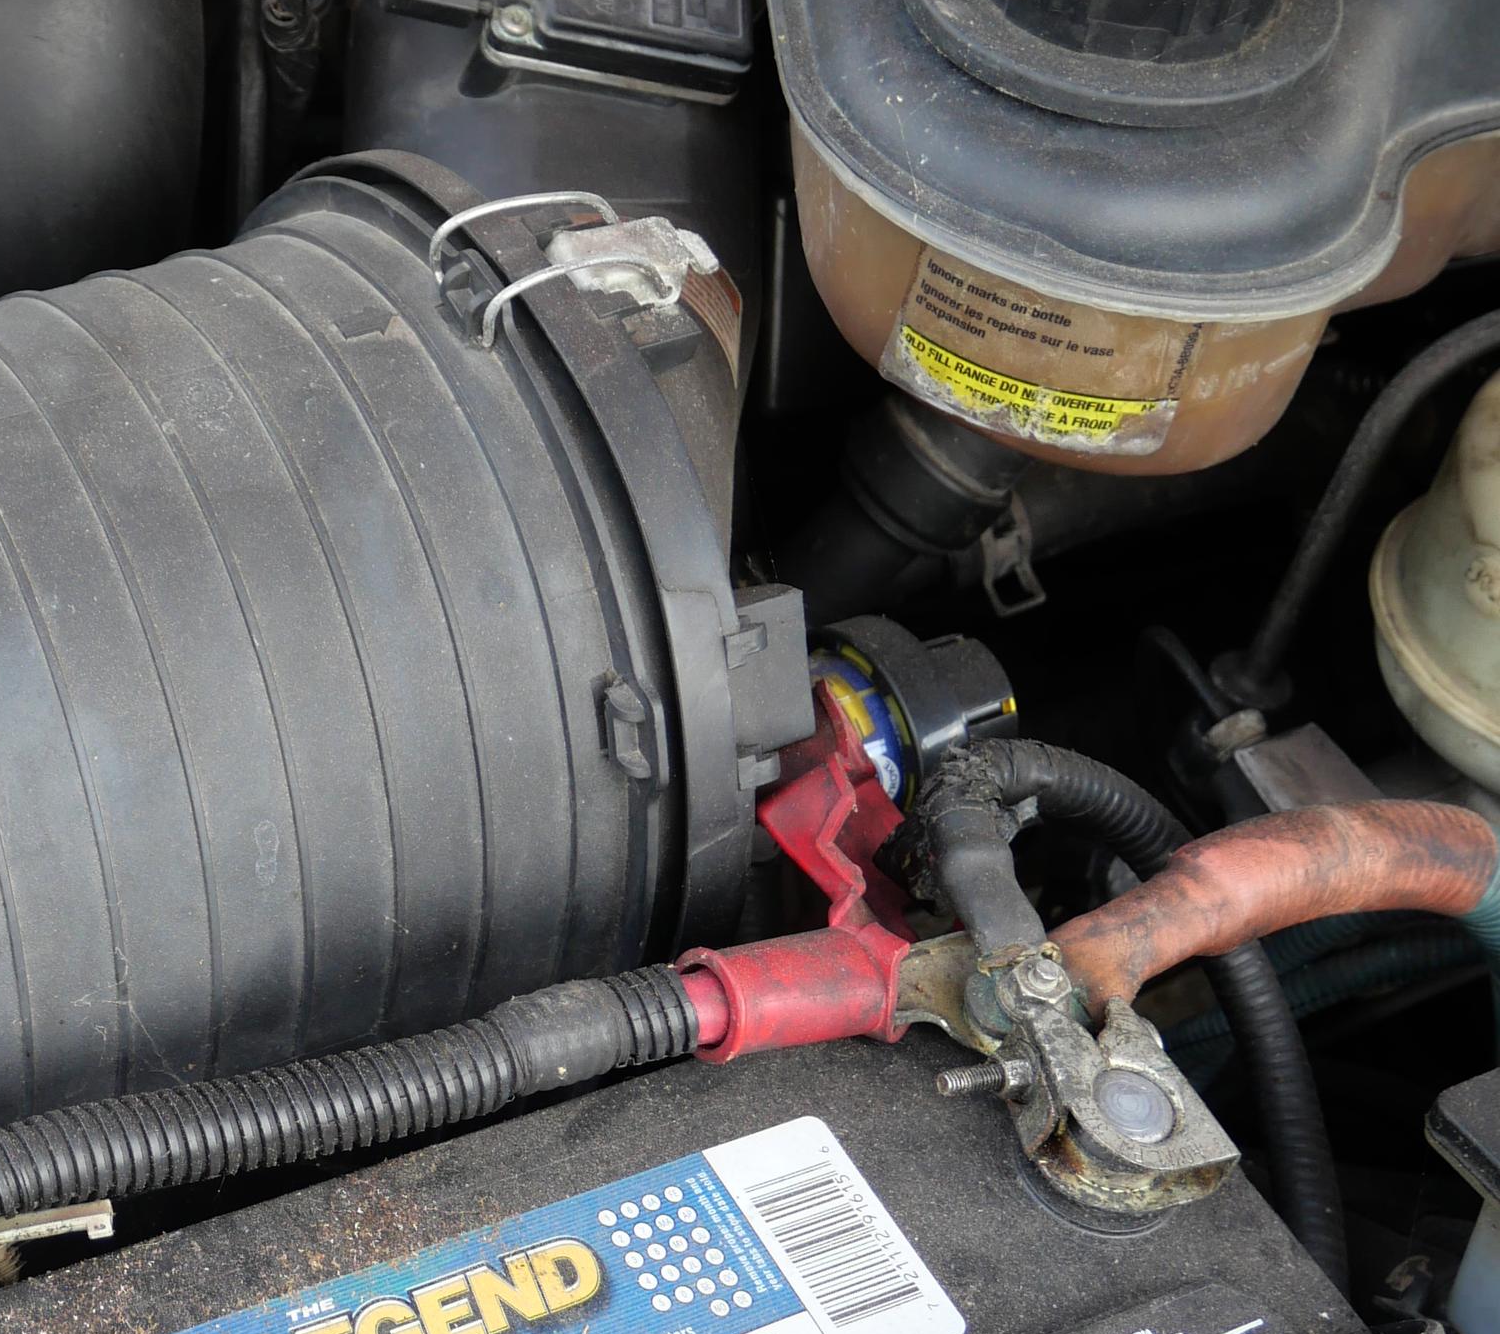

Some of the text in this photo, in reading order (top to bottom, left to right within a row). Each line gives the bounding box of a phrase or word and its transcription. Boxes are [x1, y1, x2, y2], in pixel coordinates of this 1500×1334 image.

[915, 294, 986, 339] d'expansion
[920, 279, 1114, 358] Ignorer les repères sur le vase
[927, 258, 1071, 328] Ignore marks on bottle
[928, 343, 951, 367] FILL
[954, 359, 997, 387] RANGE
[999, 378, 1019, 395] DO
[1051, 394, 1117, 415] OVERFILL
[710, 1190, 730, 1213] date
[684, 1175, 767, 1294] Remove proper month and
[747, 1246, 766, 1268] tabs
[286, 1298, 335, 1321] THE
